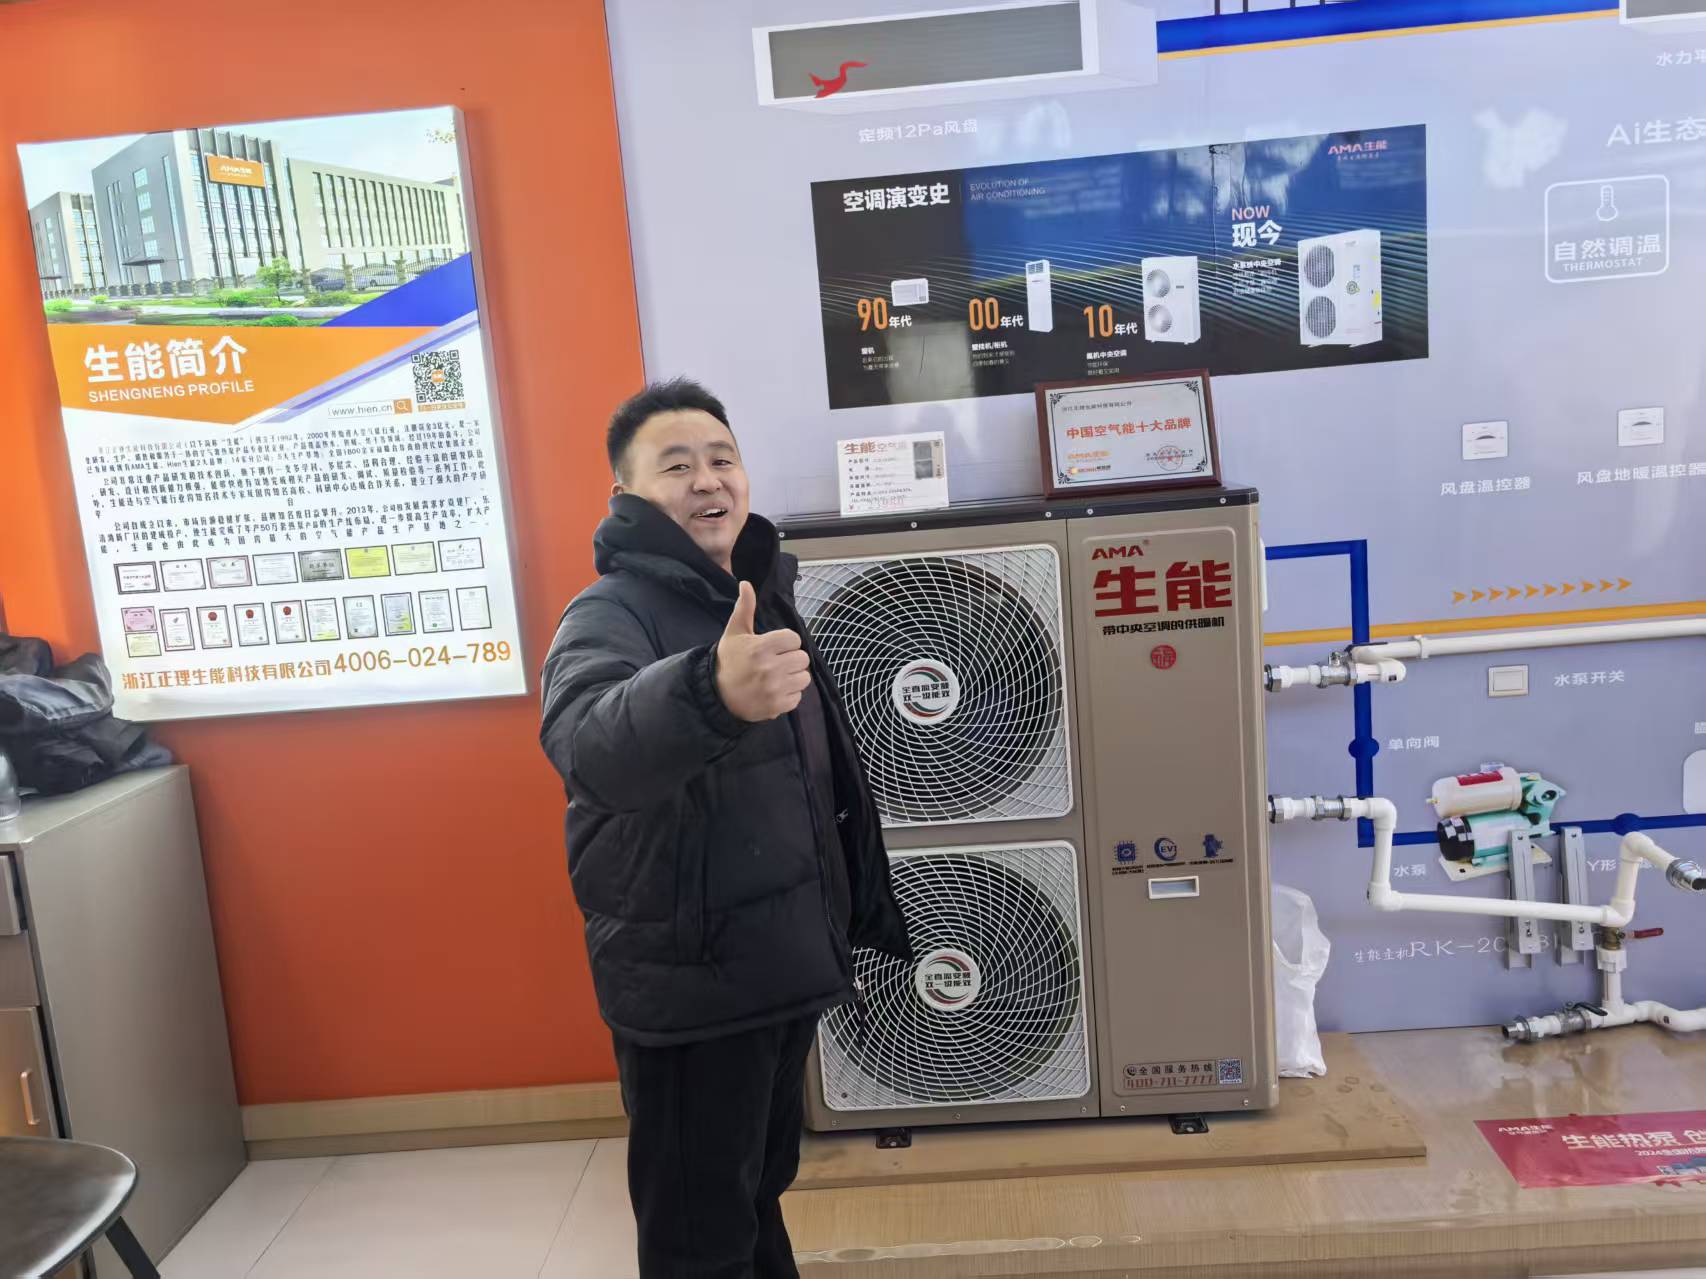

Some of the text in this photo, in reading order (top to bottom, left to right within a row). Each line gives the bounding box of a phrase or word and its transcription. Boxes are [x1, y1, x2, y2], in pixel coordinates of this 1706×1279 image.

[969, 180, 1017, 192] EVOLUTION
[842, 183, 951, 212] 空调演变史
[971, 192, 985, 201] AIR
[1231, 205, 1270, 221] NOW
[1232, 220, 1283, 248] 现今
[1554, 233, 1662, 263] 自然调温
[1562, 257, 1645, 272] THERMOSTAT
[84, 335, 248, 383] 生能简介
[88, 380, 255, 404] SHENGNENG PROFILE
[332, 404, 394, 416] www.hien.cn
[1066, 416, 1193, 440] 中国空气能十大品牌
[1440, 475, 1531, 496] 风盘温控器
[1092, 545, 1144, 561] AMA
[1093, 560, 1233, 618] 生能
[1103, 617, 1225, 636] 带中央空调的供暖机
[122, 641, 511, 690] 浙江正理生能科技有限公司 4006-024-789
[1553, 670, 1626, 687] 水泵开关
[1388, 736, 1440, 751] 单向阀
[1393, 863, 1427, 877] 水泵
[1139, 1063, 1214, 1076] 全国服务热线
[1561, 1130, 1682, 1150] 生能热泵
